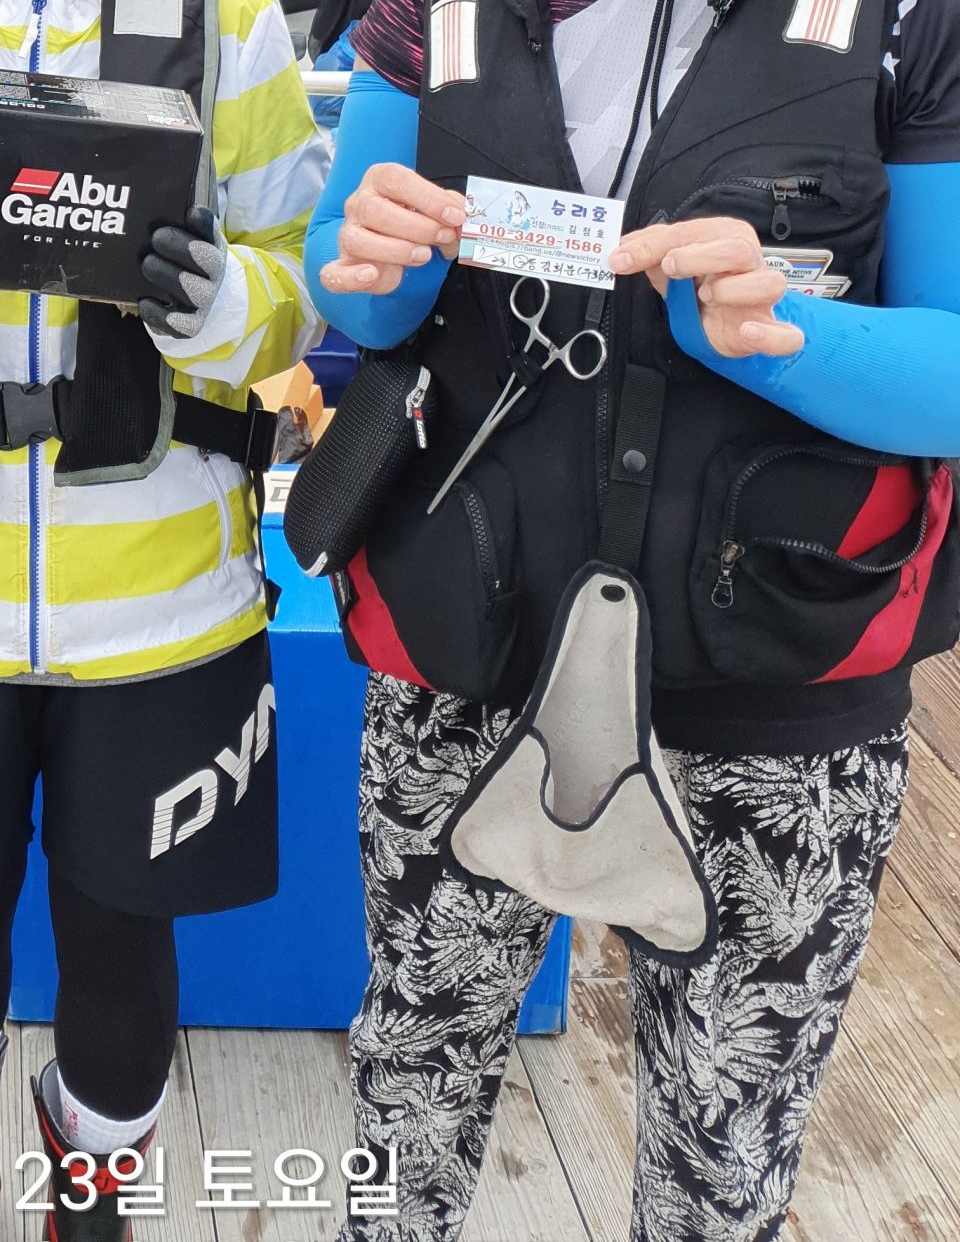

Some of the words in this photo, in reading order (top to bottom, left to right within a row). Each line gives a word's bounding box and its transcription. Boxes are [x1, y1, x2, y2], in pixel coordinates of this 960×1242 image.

[49, 172, 130, 208] Abu
[1, 193, 126, 235] Garcia
[551, 199, 607, 223] 승리호
[23, 234, 53, 245] FOR
[65, 238, 103, 248] LIFE
[480, 223, 602, 254] 010-3429-1586
